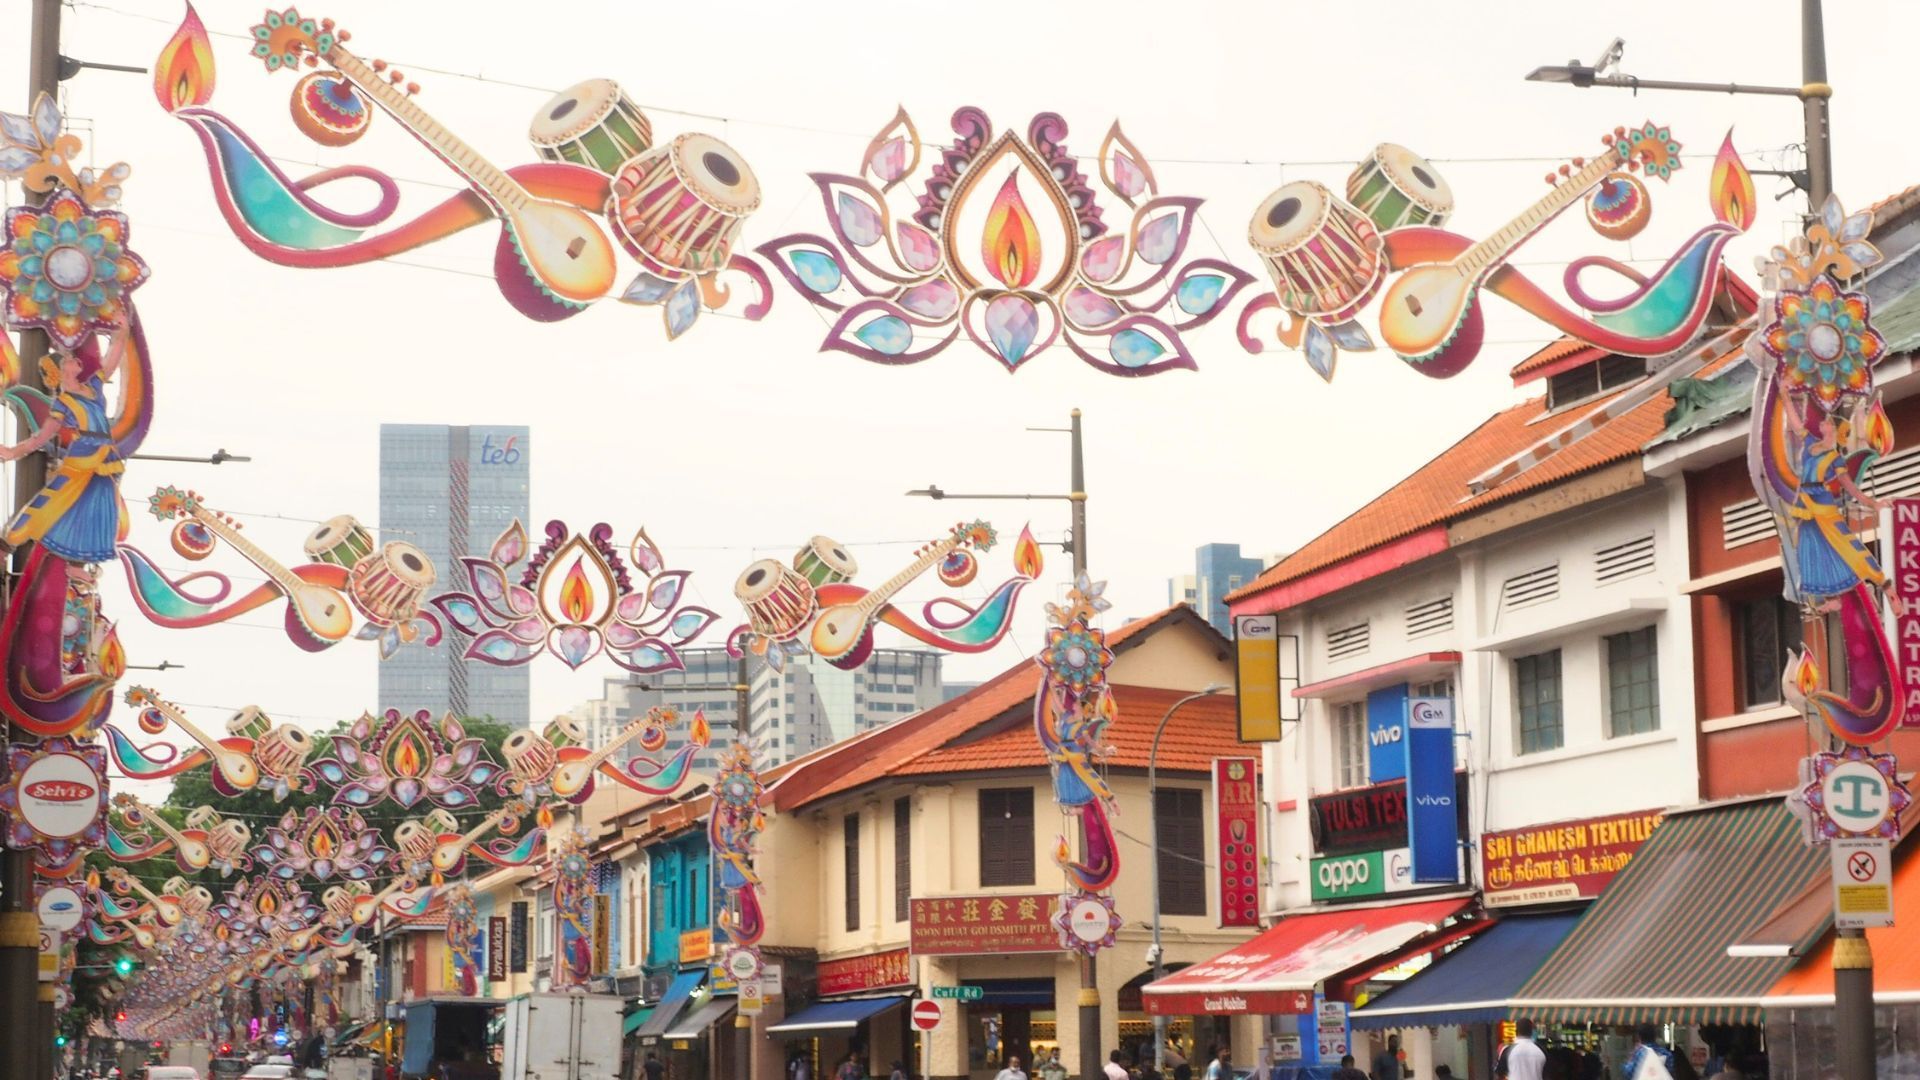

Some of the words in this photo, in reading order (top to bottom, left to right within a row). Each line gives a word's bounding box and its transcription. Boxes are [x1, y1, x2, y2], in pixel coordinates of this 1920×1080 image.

[1898, 504, 1920, 708] NAKSHATRA
[1422, 709, 1444, 719] GM
[1371, 724, 1401, 747] vivo
[33, 784, 88, 798] Selvi's
[1223, 782, 1254, 803] AR
[1416, 795, 1451, 806] vivo
[1322, 796, 1370, 833] TULSI
[1487, 836, 1512, 860] SRI
[1516, 825, 1587, 857] GHANESH
[1319, 859, 1369, 892] oppo
[915, 927, 940, 936] SOON
[943, 926, 967, 936] HUAT
[971, 925, 1027, 936] GOLDSMITH
[1030, 924, 1048, 934] PTE
[492, 920, 504, 977] Joyalukkas
[934, 988, 959, 998] Cuff
[963, 987, 978, 998] Rd
[1204, 997, 1222, 1011] Grand
[1223, 997, 1247, 1011] Mobiles
